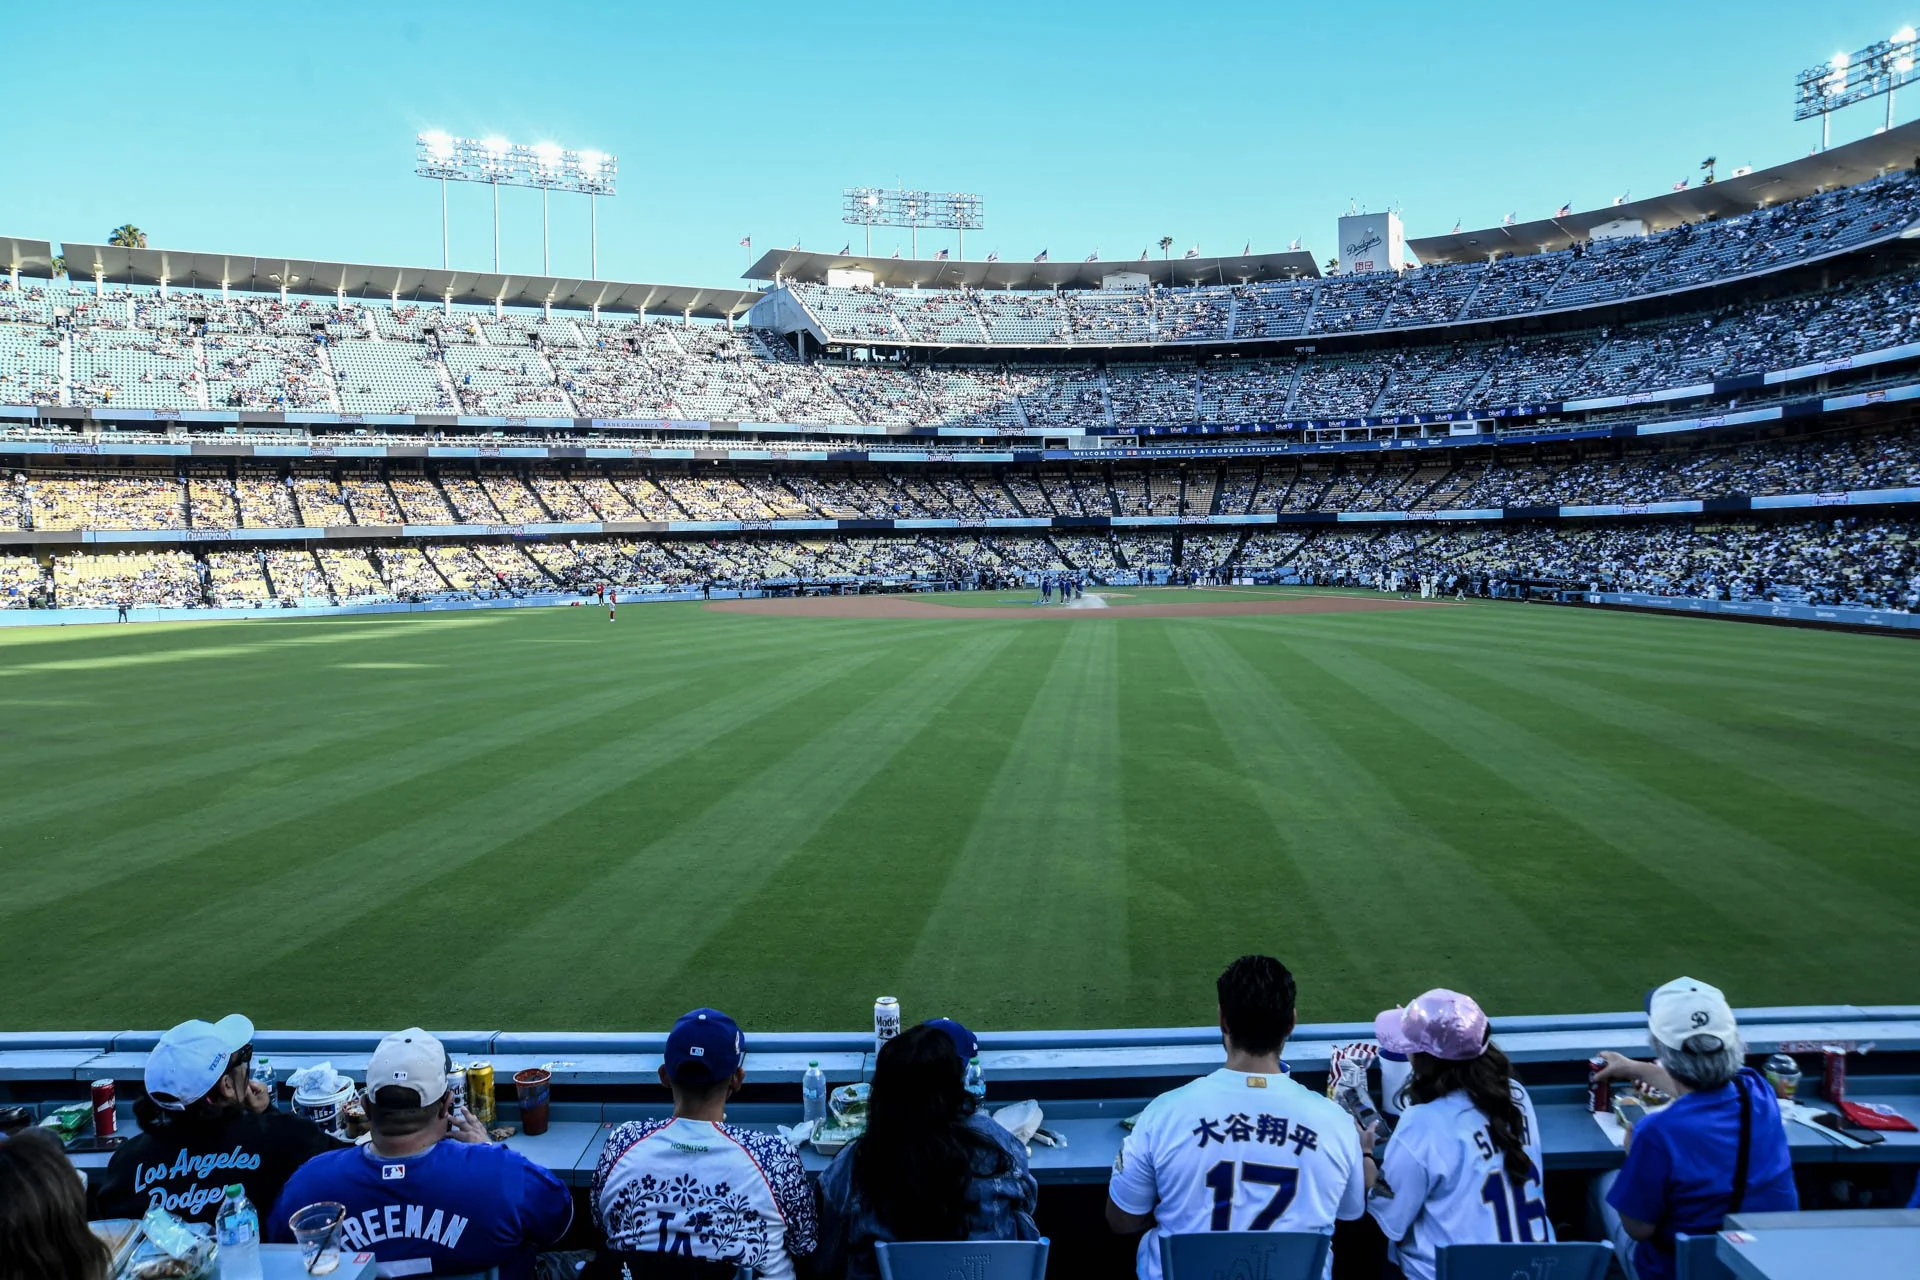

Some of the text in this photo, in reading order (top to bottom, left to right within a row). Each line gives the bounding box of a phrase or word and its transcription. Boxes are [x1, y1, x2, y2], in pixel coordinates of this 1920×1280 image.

[1346, 235, 1382, 256] Dodgers
[52, 444, 98, 454] CHAMPIONS
[187, 531, 232, 541] CHAMPIONS
[671, 1142, 709, 1153] HORNITOS
[1193, 1112, 1318, 1156] 大谷翔平
[135, 1146, 260, 1194] Los Angeles
[148, 1183, 229, 1215] Dodger
[1206, 1160, 1299, 1231] 17
[1481, 1163, 1549, 1242] 16
